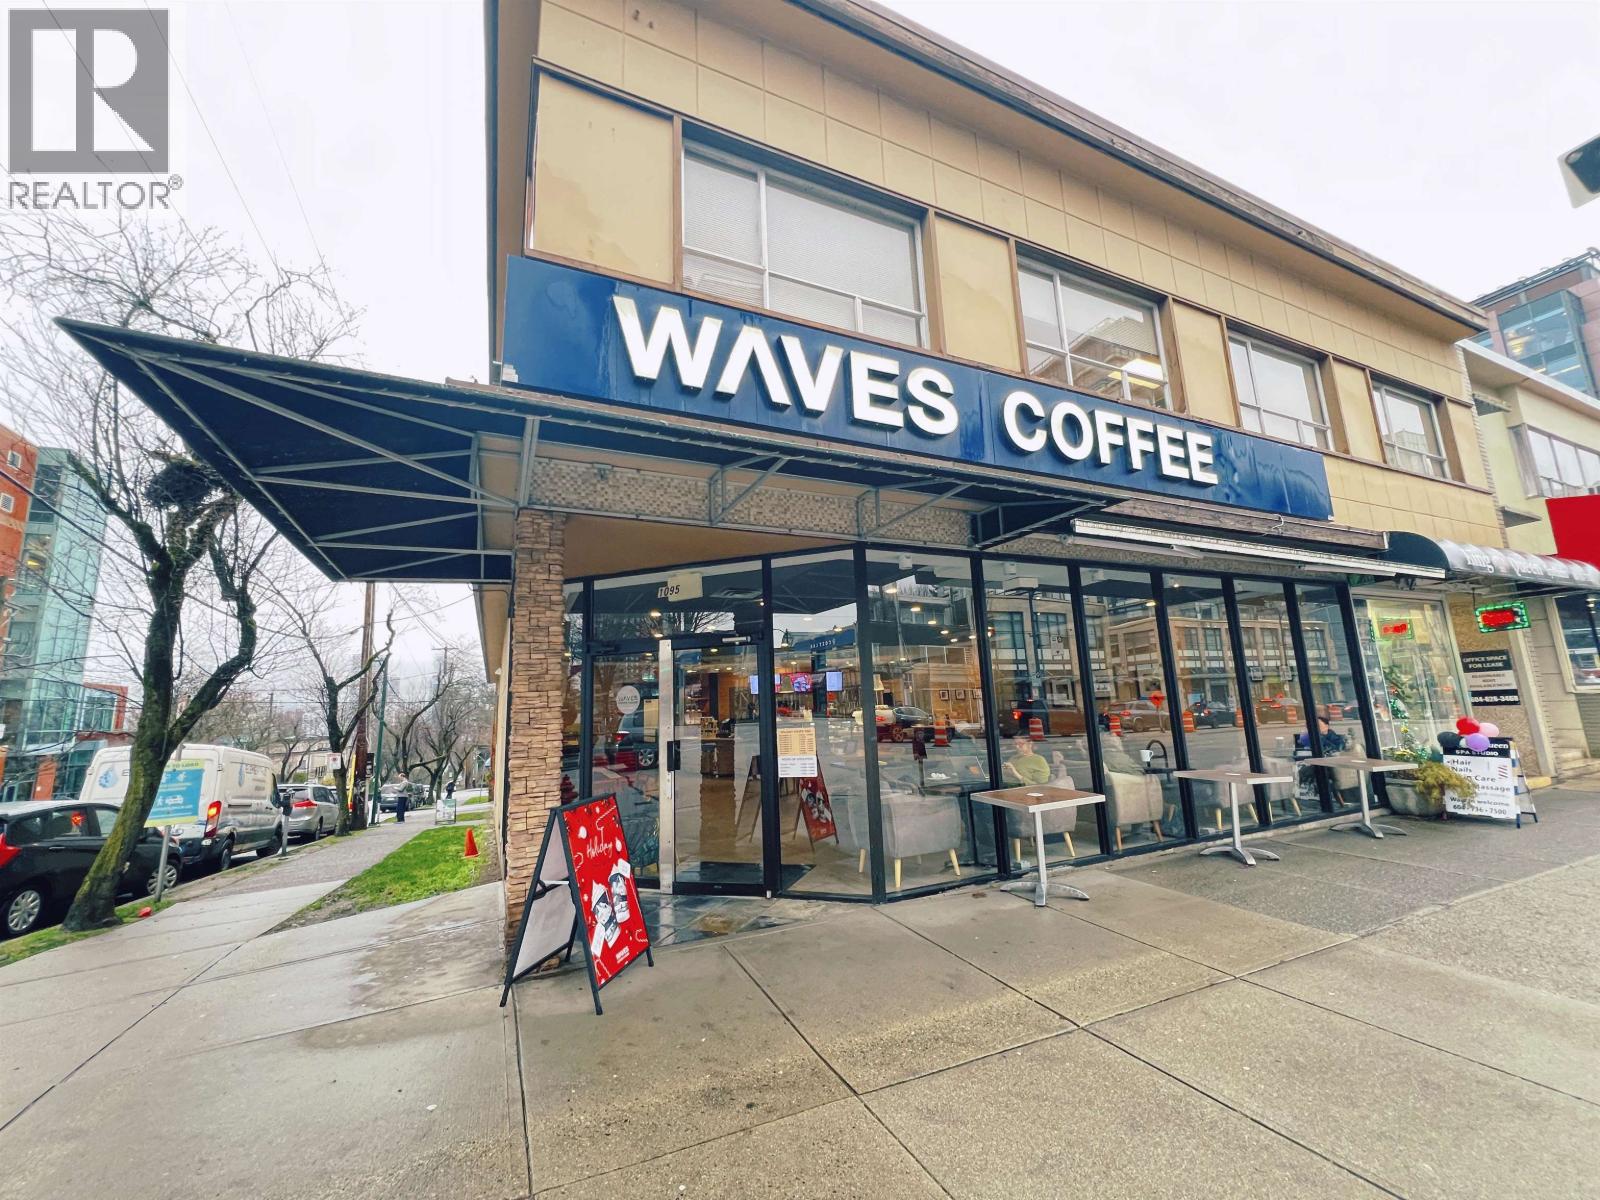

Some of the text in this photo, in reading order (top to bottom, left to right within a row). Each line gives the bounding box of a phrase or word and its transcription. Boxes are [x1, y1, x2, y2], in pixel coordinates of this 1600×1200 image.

[612, 296, 1219, 486] WAVES COFFEE
[659, 585, 680, 596] 1095
